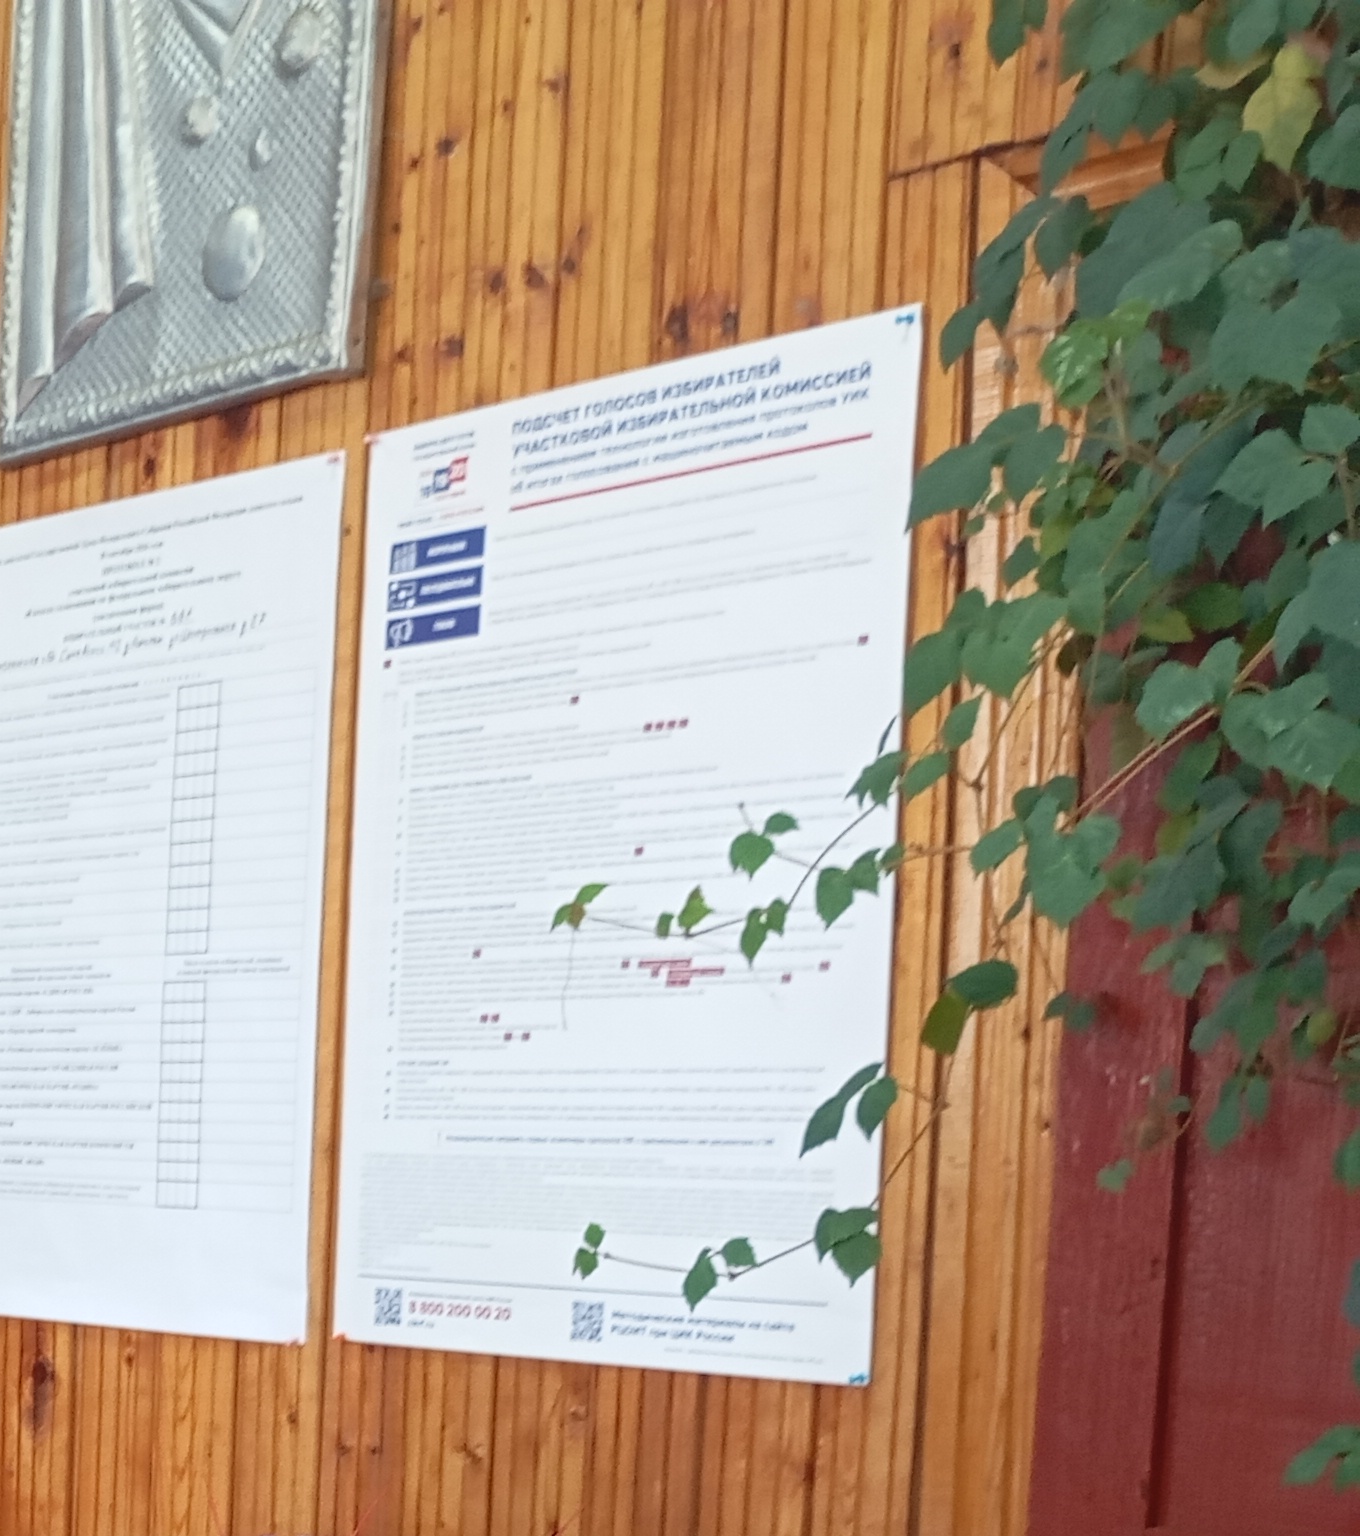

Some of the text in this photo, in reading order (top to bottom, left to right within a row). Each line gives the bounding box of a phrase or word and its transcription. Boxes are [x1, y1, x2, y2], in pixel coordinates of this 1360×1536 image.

[512, 355, 780, 434] ПОДСЧЕТ ГОЛОСОВ ИЗБИРАТЕЛЕЙ
[513, 419, 613, 459] УЧАСТКОВОЙ
[617, 387, 756, 434] ИЗБИРАТЕЛЬНОЙ
[760, 360, 872, 401] КОМИССИЕЙ
[419, 1301, 444, 1316] 800
[446, 1302, 471, 1318] 200
[474, 1303, 491, 1320] 00
[493, 1304, 512, 1321] 20
